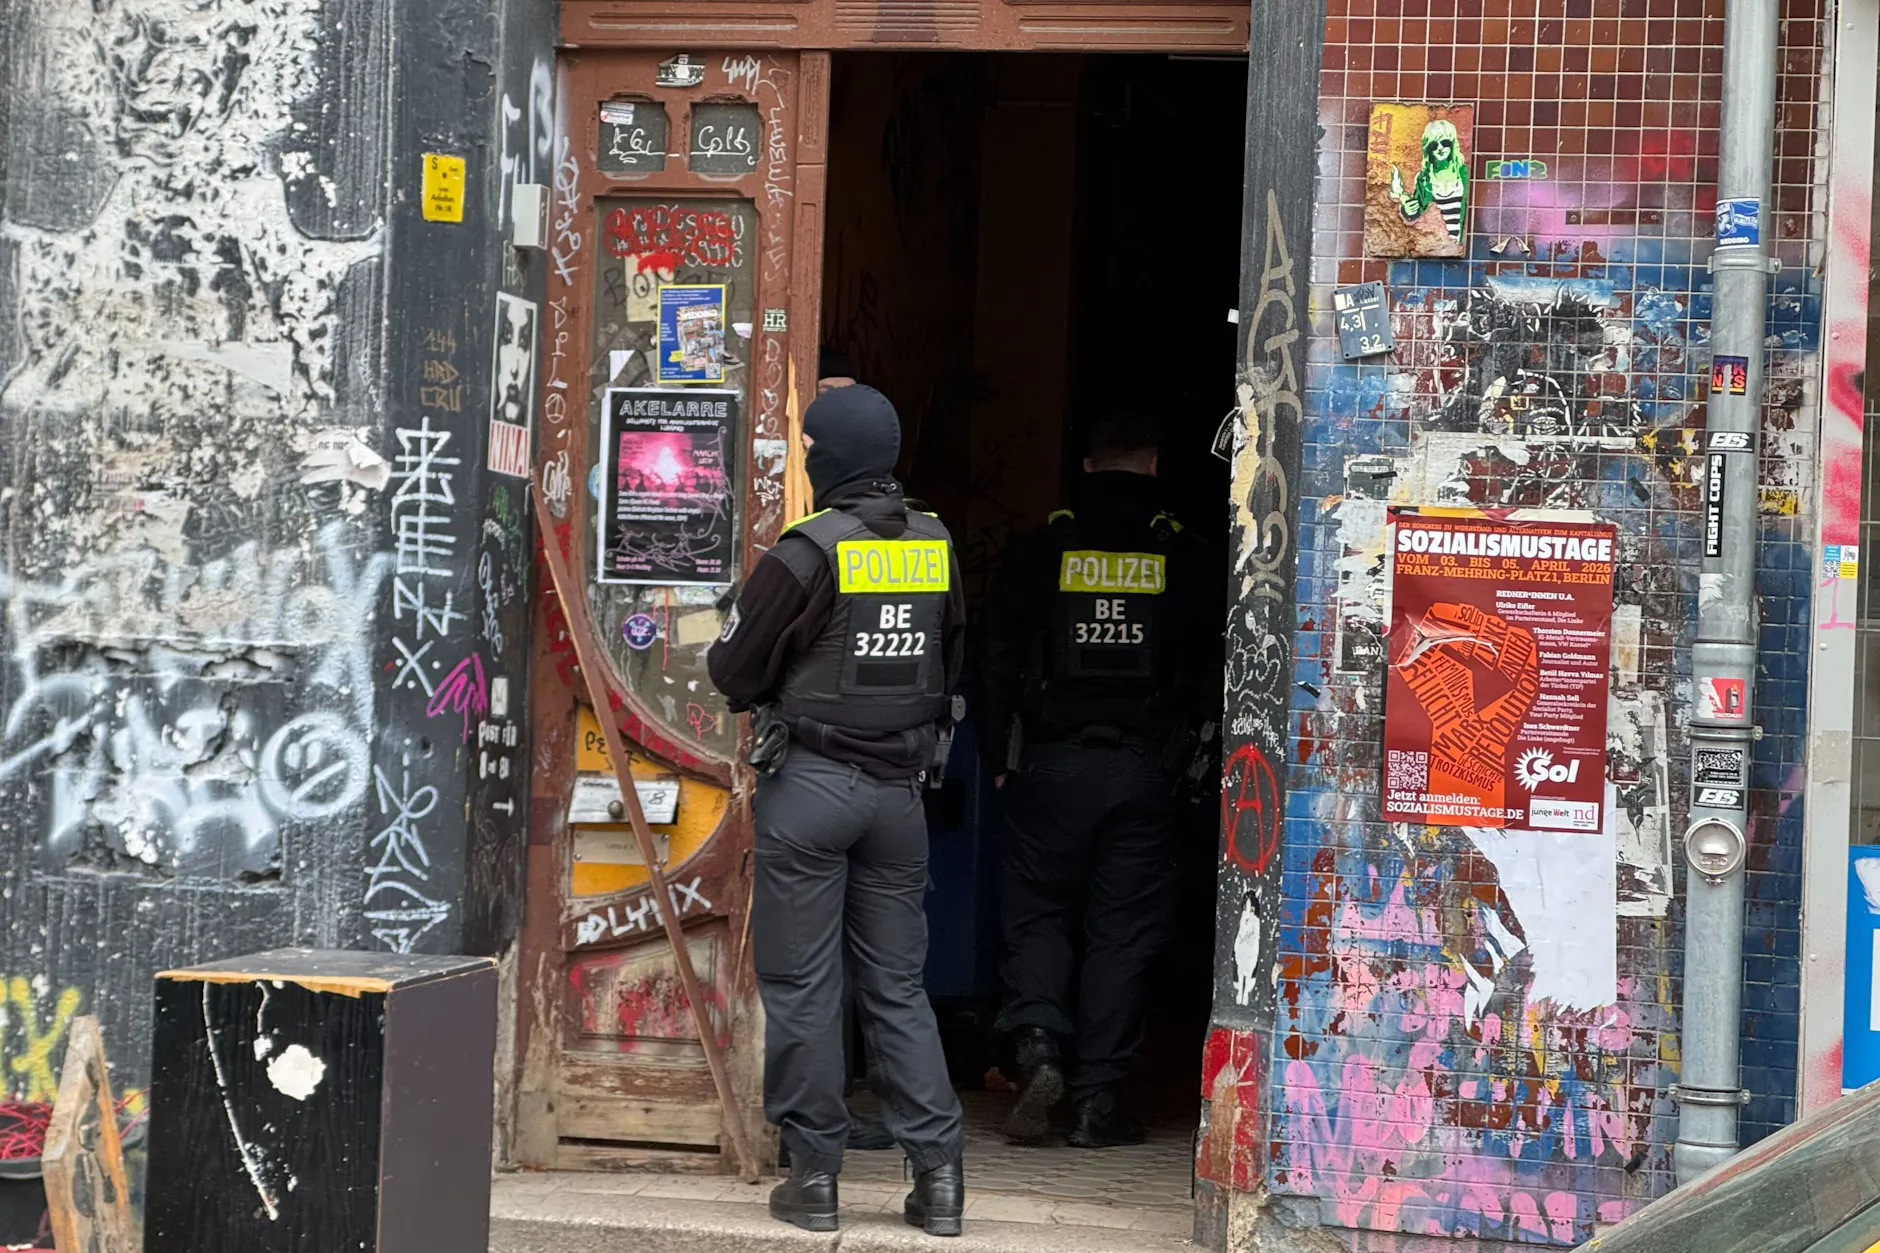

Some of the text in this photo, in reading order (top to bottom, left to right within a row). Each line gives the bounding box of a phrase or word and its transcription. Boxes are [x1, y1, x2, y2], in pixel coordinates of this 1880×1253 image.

[1340, 314, 1362, 332] 4,3
[618, 399, 728, 418] AKELARRE
[1707, 454, 1722, 555] FIGHT COPS
[1397, 529, 1612, 562] SOZIALISMUSTAGE
[846, 548, 945, 585] POLIZEI
[1065, 556, 1162, 590] POLIZEI
[1397, 553, 1611, 574] VOM 03. BIS 05. APRIL 2026
[1562, 574, 1611, 585] BERLIN
[879, 603, 912, 629] BE
[1095, 599, 1126, 620] BE
[854, 632, 926, 657] 32222
[1075, 621, 1144, 645] 32215
[1500, 630, 1535, 683] ANTIFA
[1431, 655, 1475, 719] FEMINISMUS
[1468, 664, 1538, 777] REVOLUTION
[1432, 712, 1490, 763] MARX
[1430, 753, 1496, 792] TROTZKISMUS
[1456, 752, 1504, 784] GESCHICHTE
[1531, 759, 1580, 784] Sol
[1387, 789, 1481, 806] Jetzt anmelden:
[1386, 801, 1525, 820] SOZIALISMUSTAGE.DE
[1573, 805, 1595, 820] nd
